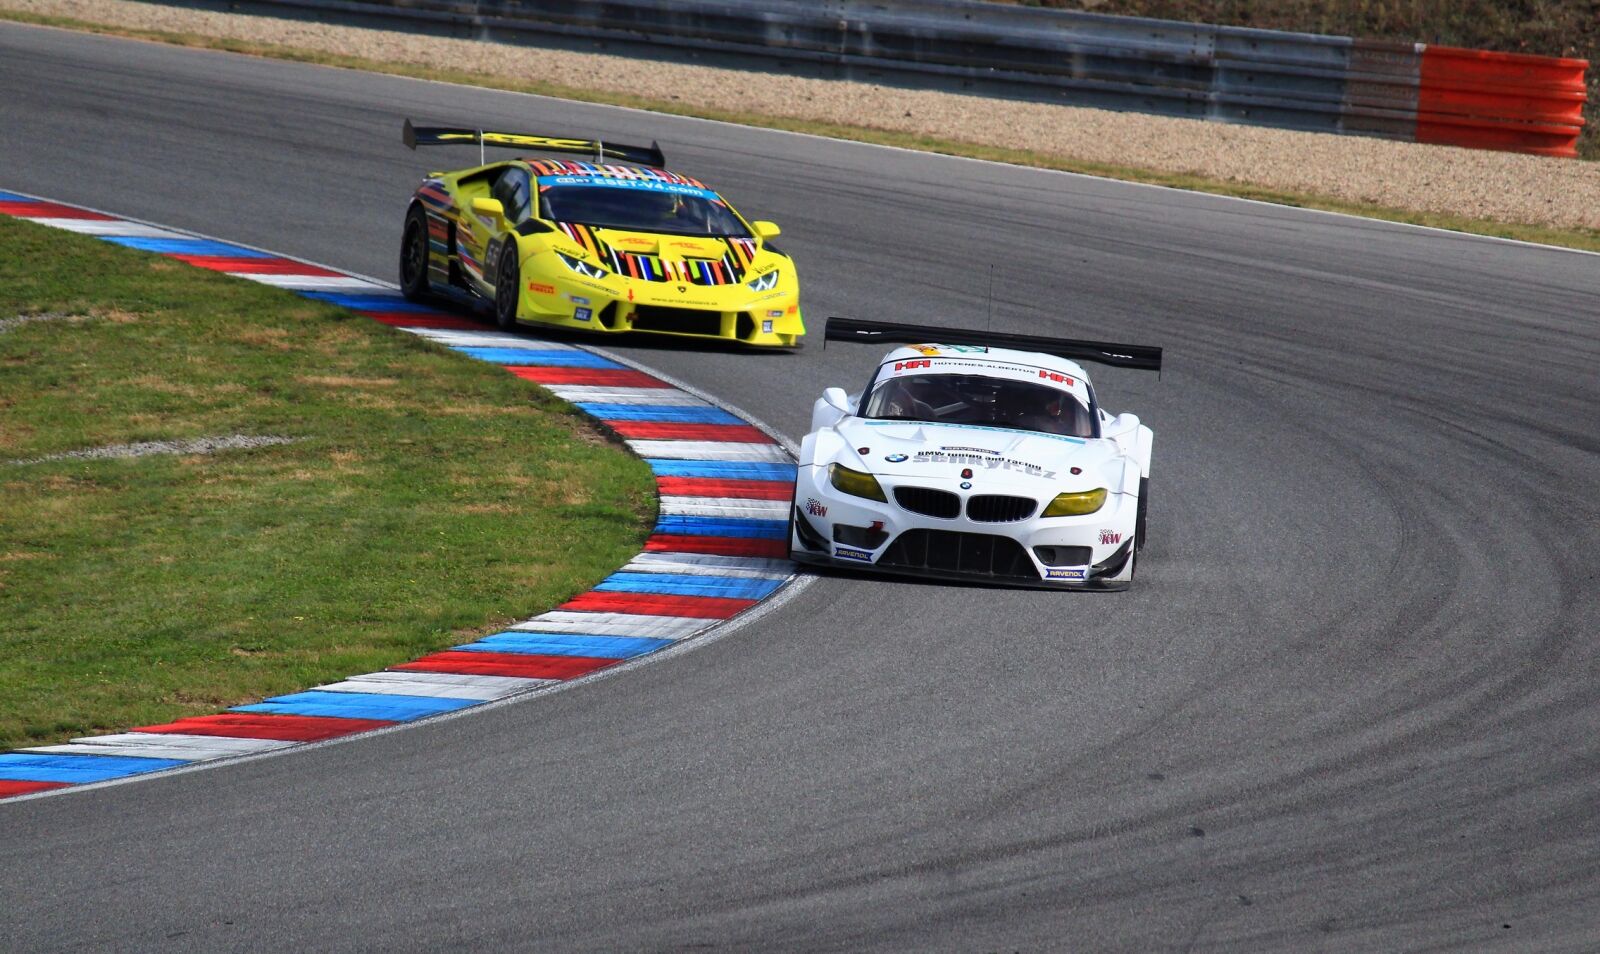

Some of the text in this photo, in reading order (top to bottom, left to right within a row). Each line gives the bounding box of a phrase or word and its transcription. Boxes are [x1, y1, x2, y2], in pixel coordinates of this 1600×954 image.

[594, 177, 703, 196] ESET-V4.com
[1007, 458, 1042, 471] racing
[1101, 533, 1122, 545] KW
[838, 550, 869, 560] RAVENOL
